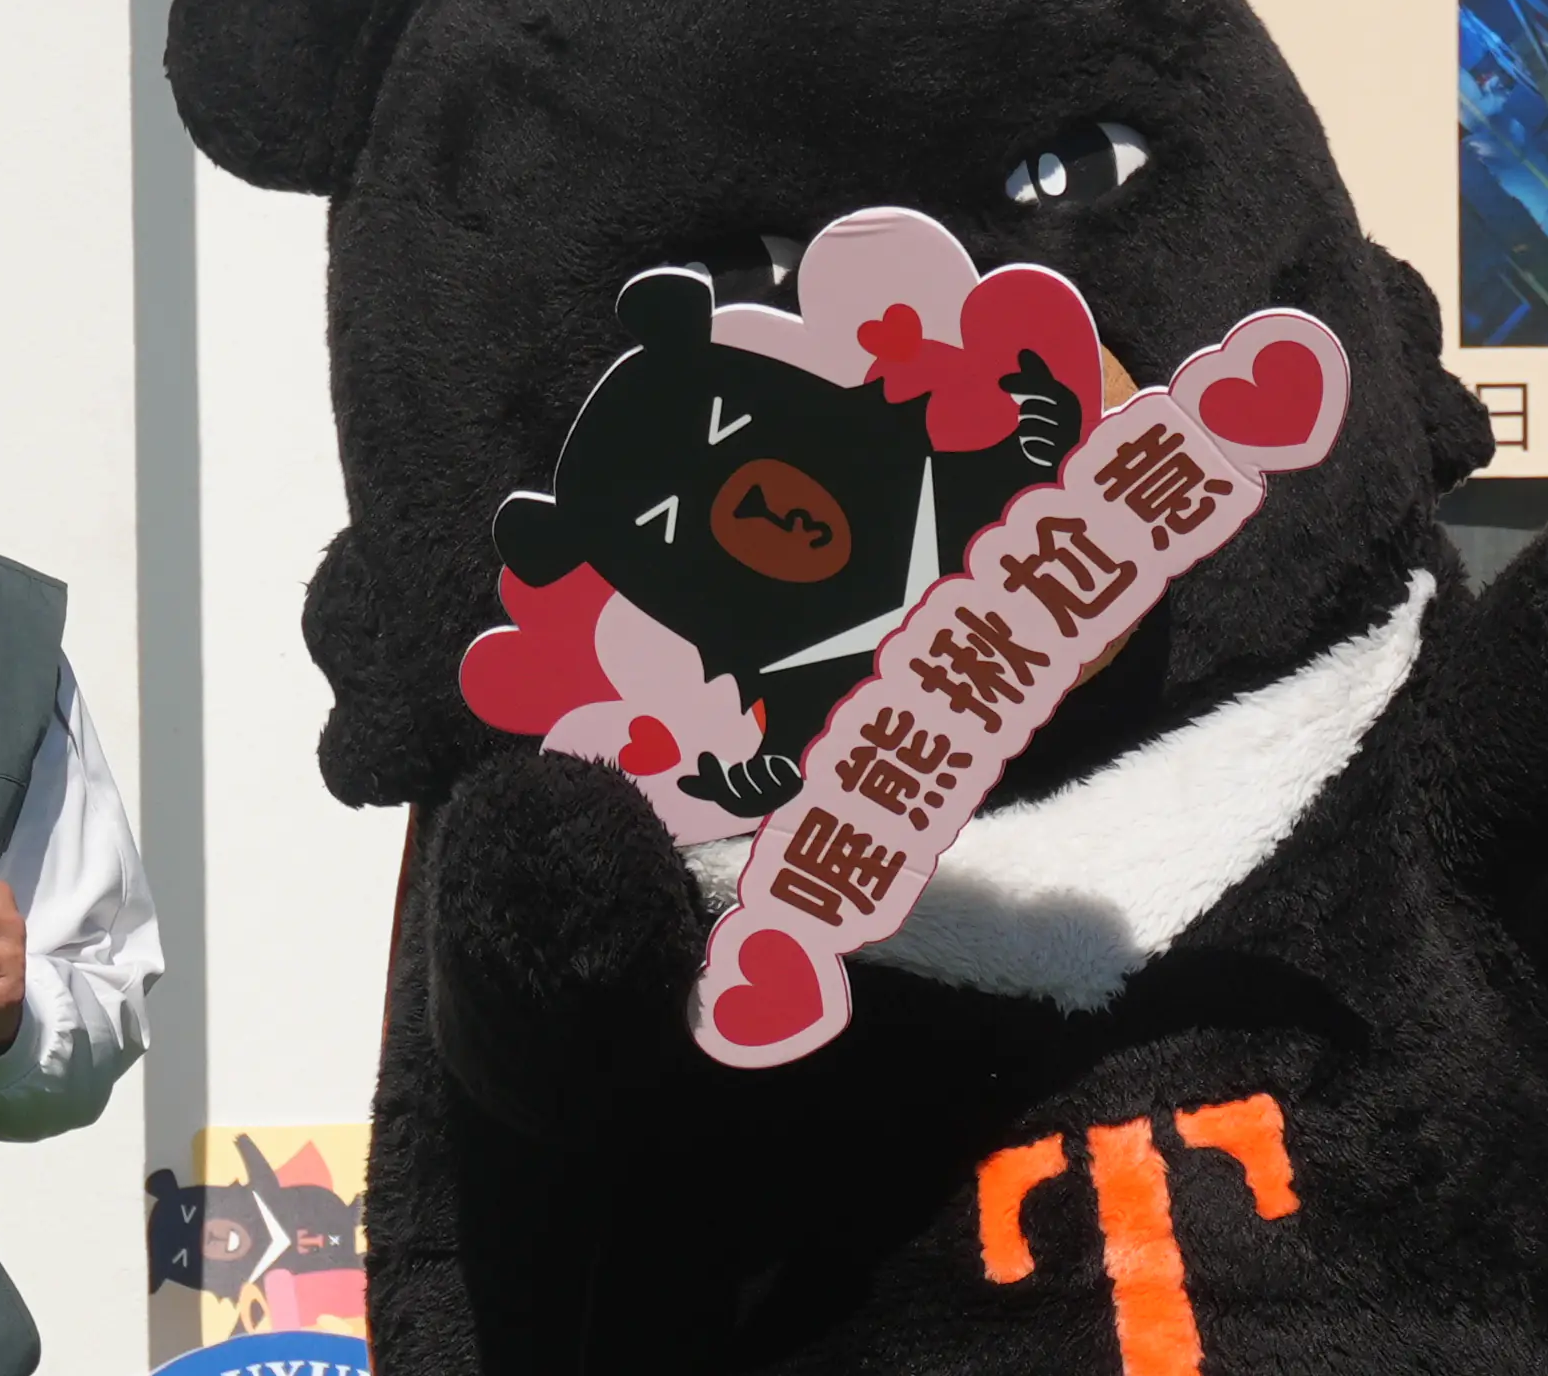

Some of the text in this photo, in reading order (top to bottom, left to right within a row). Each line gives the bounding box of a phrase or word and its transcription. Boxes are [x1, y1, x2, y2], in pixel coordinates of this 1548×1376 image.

[770, 423, 1234, 927] 喔熊揪尬意
